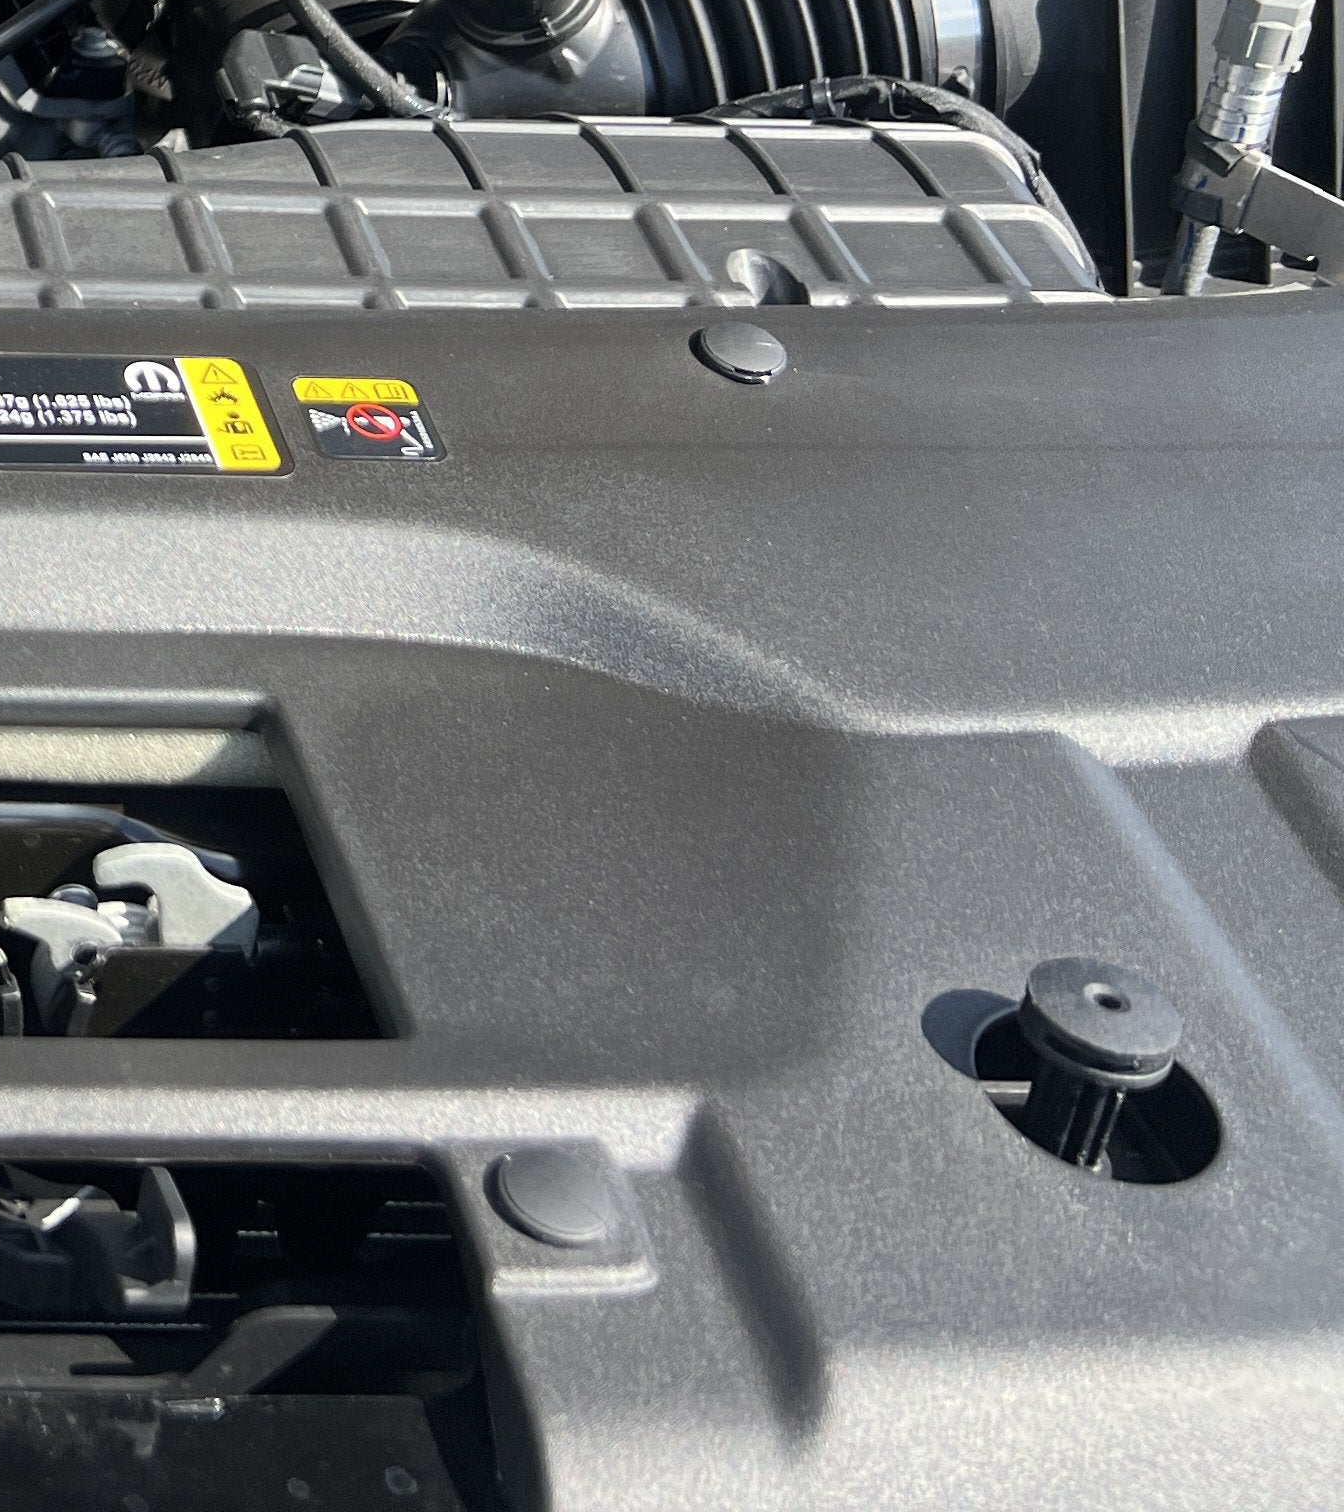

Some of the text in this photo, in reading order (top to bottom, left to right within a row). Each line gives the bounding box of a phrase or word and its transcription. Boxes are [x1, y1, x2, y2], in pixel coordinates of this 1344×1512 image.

[32, 393, 91, 411] (1.625
[93, 394, 132, 411] lbs)
[37, 409, 97, 428] (1.375
[98, 410, 137, 429] lbs)
